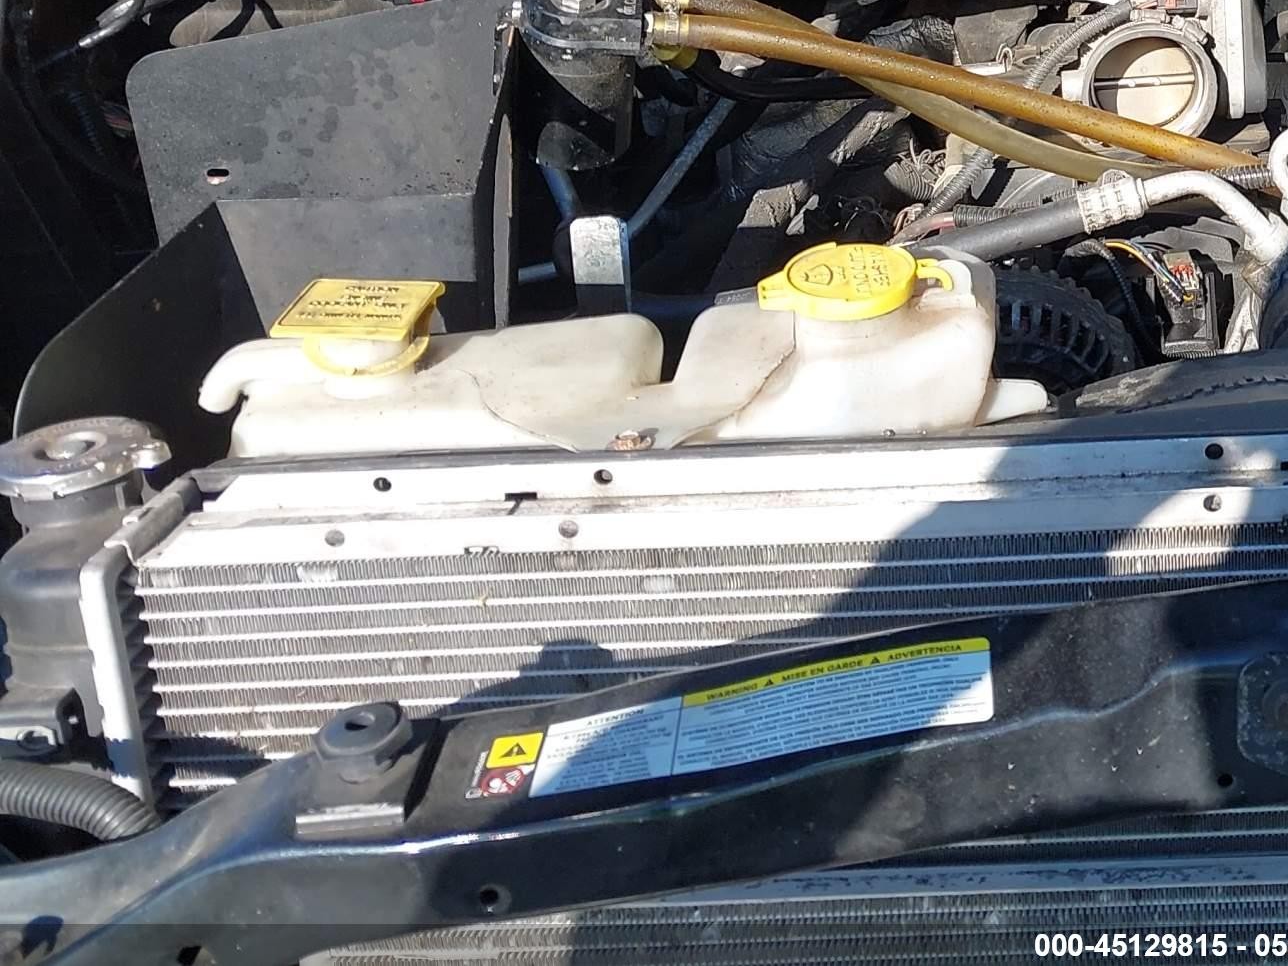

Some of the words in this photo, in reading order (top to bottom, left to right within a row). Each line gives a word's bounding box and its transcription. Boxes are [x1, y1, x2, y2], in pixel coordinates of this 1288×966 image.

[706, 682, 759, 701] WARNING
[781, 670, 808, 682] MISE
[810, 666, 825, 676] EN
[827, 659, 864, 673] GARDE
[887, 644, 963, 661] ADVERTENCIA
[586, 708, 645, 725] ATTENTION
